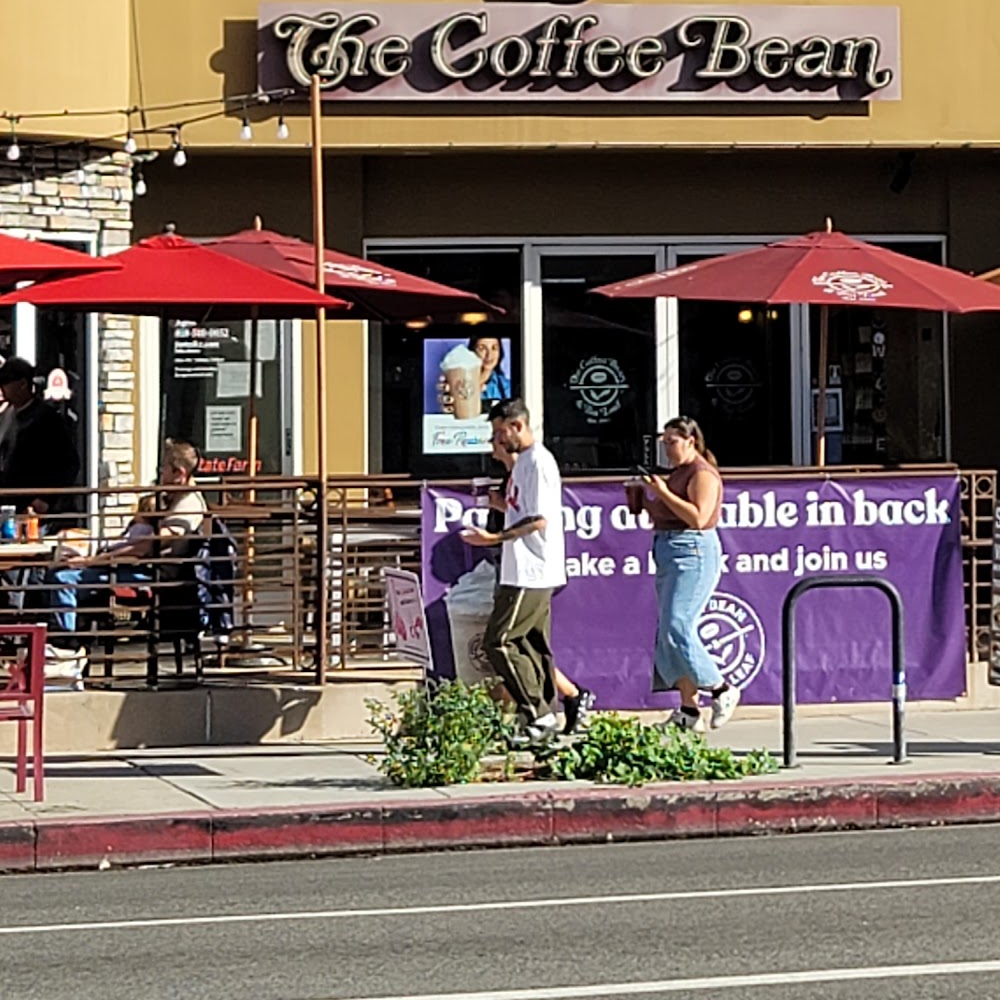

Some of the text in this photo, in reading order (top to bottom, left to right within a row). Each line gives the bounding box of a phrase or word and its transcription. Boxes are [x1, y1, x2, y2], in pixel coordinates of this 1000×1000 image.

[275, 12, 892, 89] The Coffee Bean
[434, 497, 602, 540] Pang
[806, 491, 846, 527] in
[853, 488, 951, 526] back
[565, 552, 616, 577] ake
[622, 556, 641, 575] a
[735, 548, 790, 573] and
[794, 545, 848, 576] join
[855, 550, 888, 571] us
